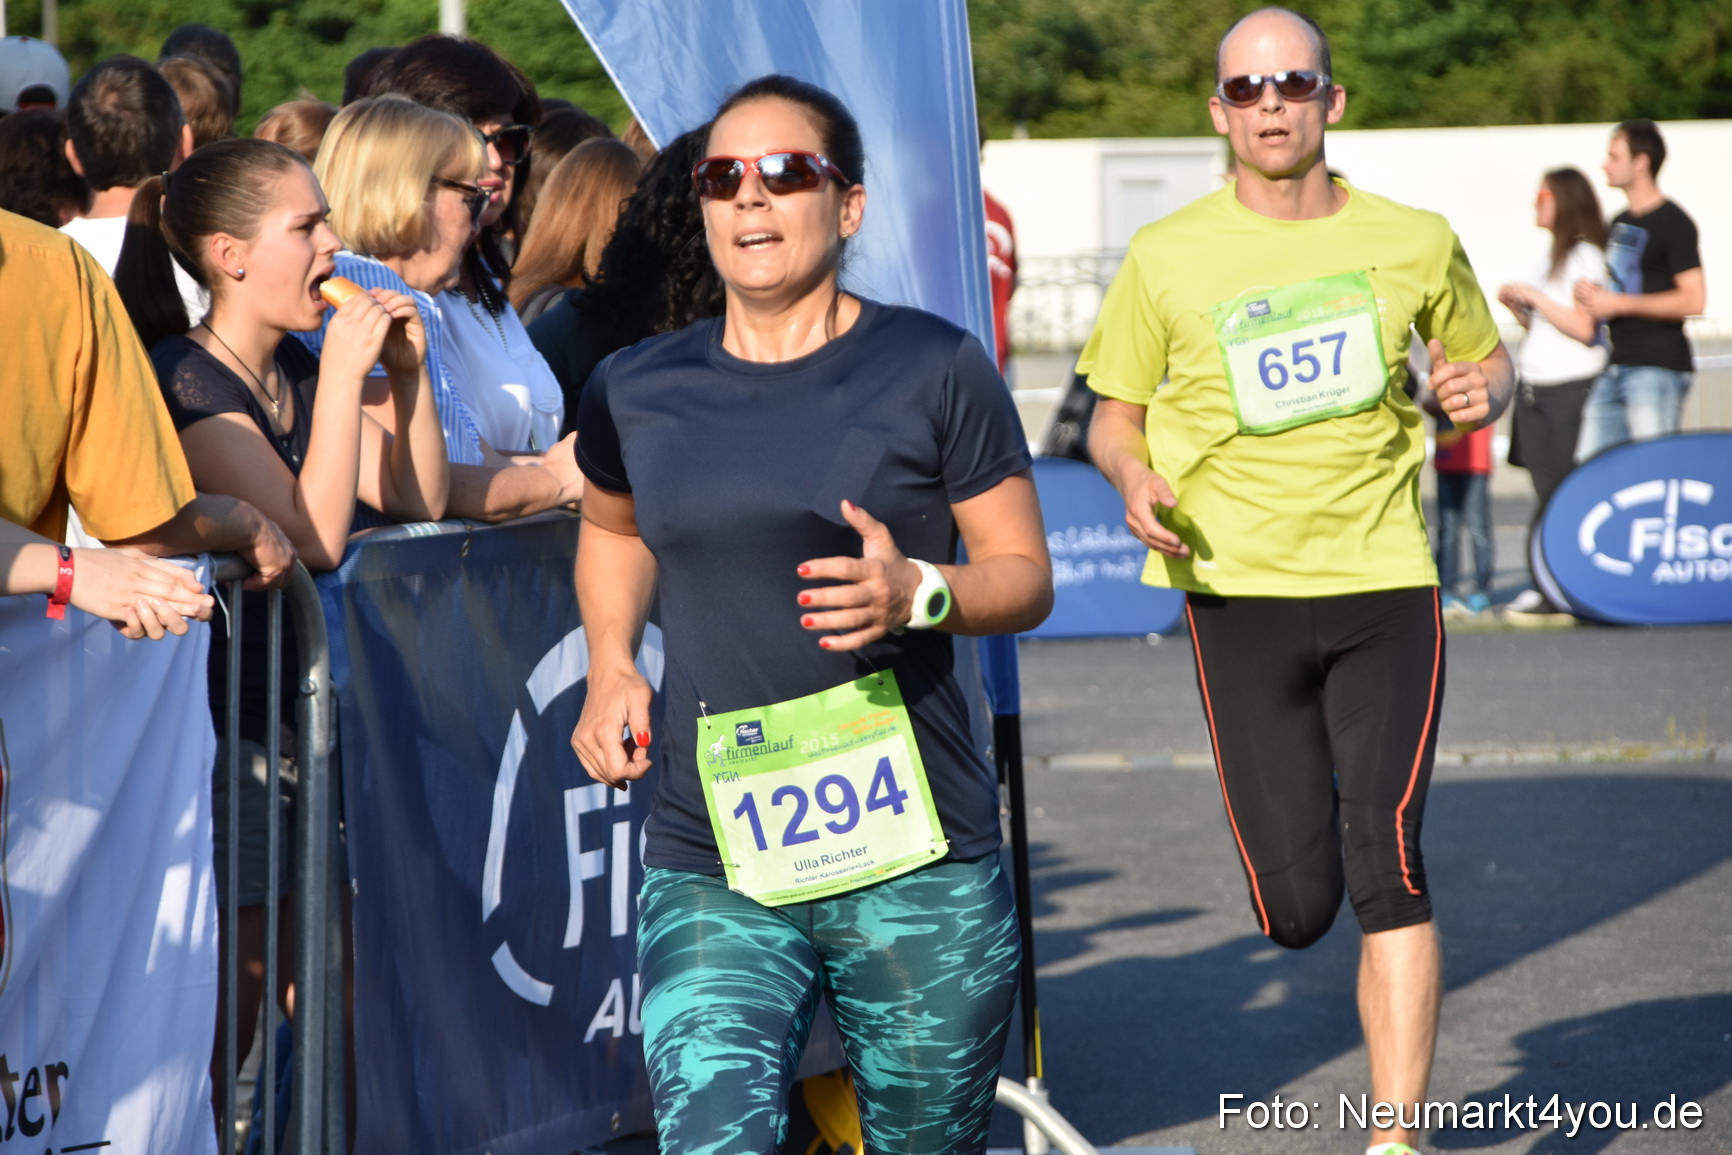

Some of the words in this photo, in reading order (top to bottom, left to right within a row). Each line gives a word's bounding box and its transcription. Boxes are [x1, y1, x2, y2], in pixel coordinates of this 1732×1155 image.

[1258, 331, 1347, 390] 657
[1275, 392, 1318, 409] Christian
[1319, 385, 1351, 400] Krüger
[1628, 515, 1732, 564] Fisc
[1651, 558, 1732, 585] AUTO
[726, 734, 794, 760] firmenlauf
[800, 732, 840, 754] 2015
[733, 756, 908, 852] 1294
[562, 780, 648, 949] Fi
[794, 858, 820, 872] Ulla
[820, 845, 868, 867] Richter
[794, 873, 818, 885] Richter
[819, 859, 875, 879] Karosserie+Lack
[0, 1053, 69, 1141] ter
